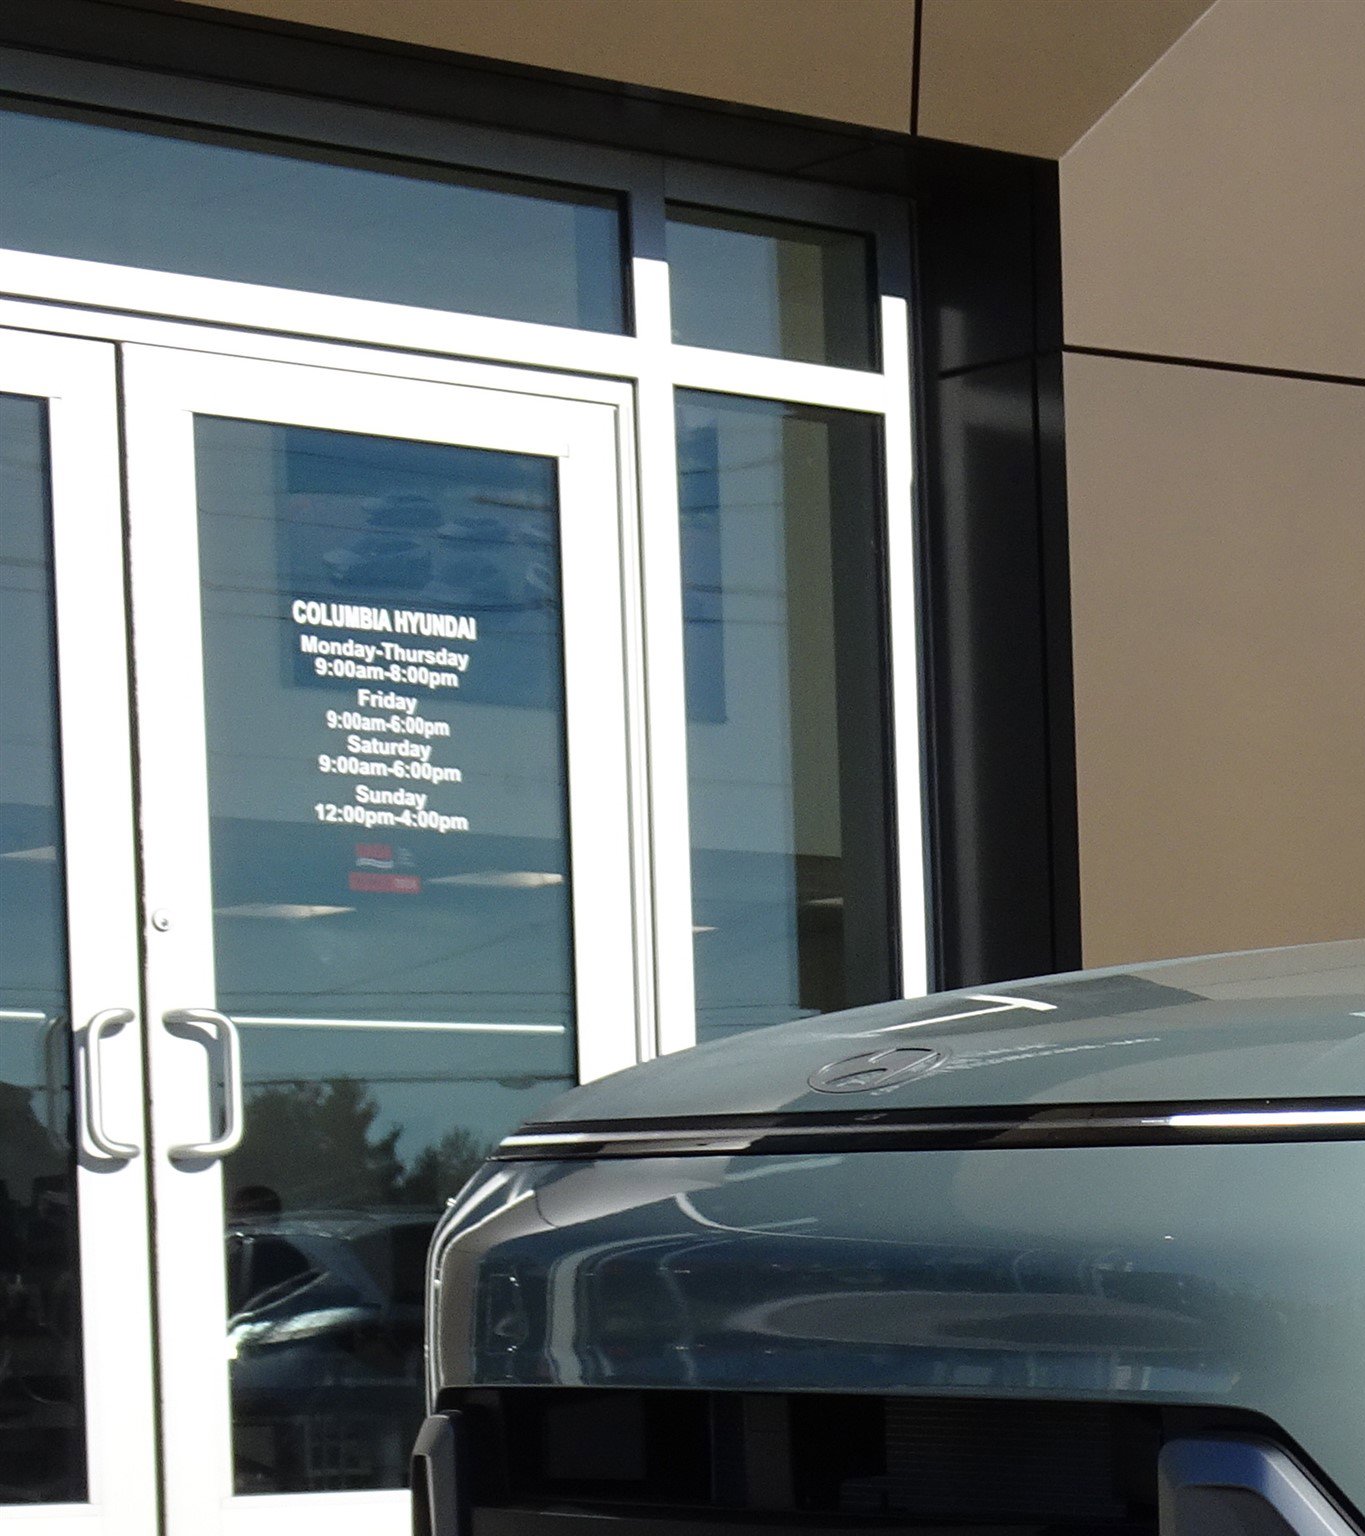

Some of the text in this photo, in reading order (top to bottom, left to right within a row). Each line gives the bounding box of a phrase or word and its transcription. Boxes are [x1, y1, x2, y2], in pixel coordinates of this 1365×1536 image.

[292, 600, 477, 640] COLUMBIA HYUNDAI
[300, 634, 469, 671] Monday-Thursday
[315, 657, 459, 689] 9:00am-8:00pm
[357, 688, 417, 715] Friday
[326, 710, 450, 738] 9:00am-6:00pm
[347, 734, 432, 762] Saturday
[318, 754, 462, 784] 9:00am-6:00pm
[355, 784, 427, 810] Sunday
[315, 803, 469, 833] 12:00pm-4:00pm
